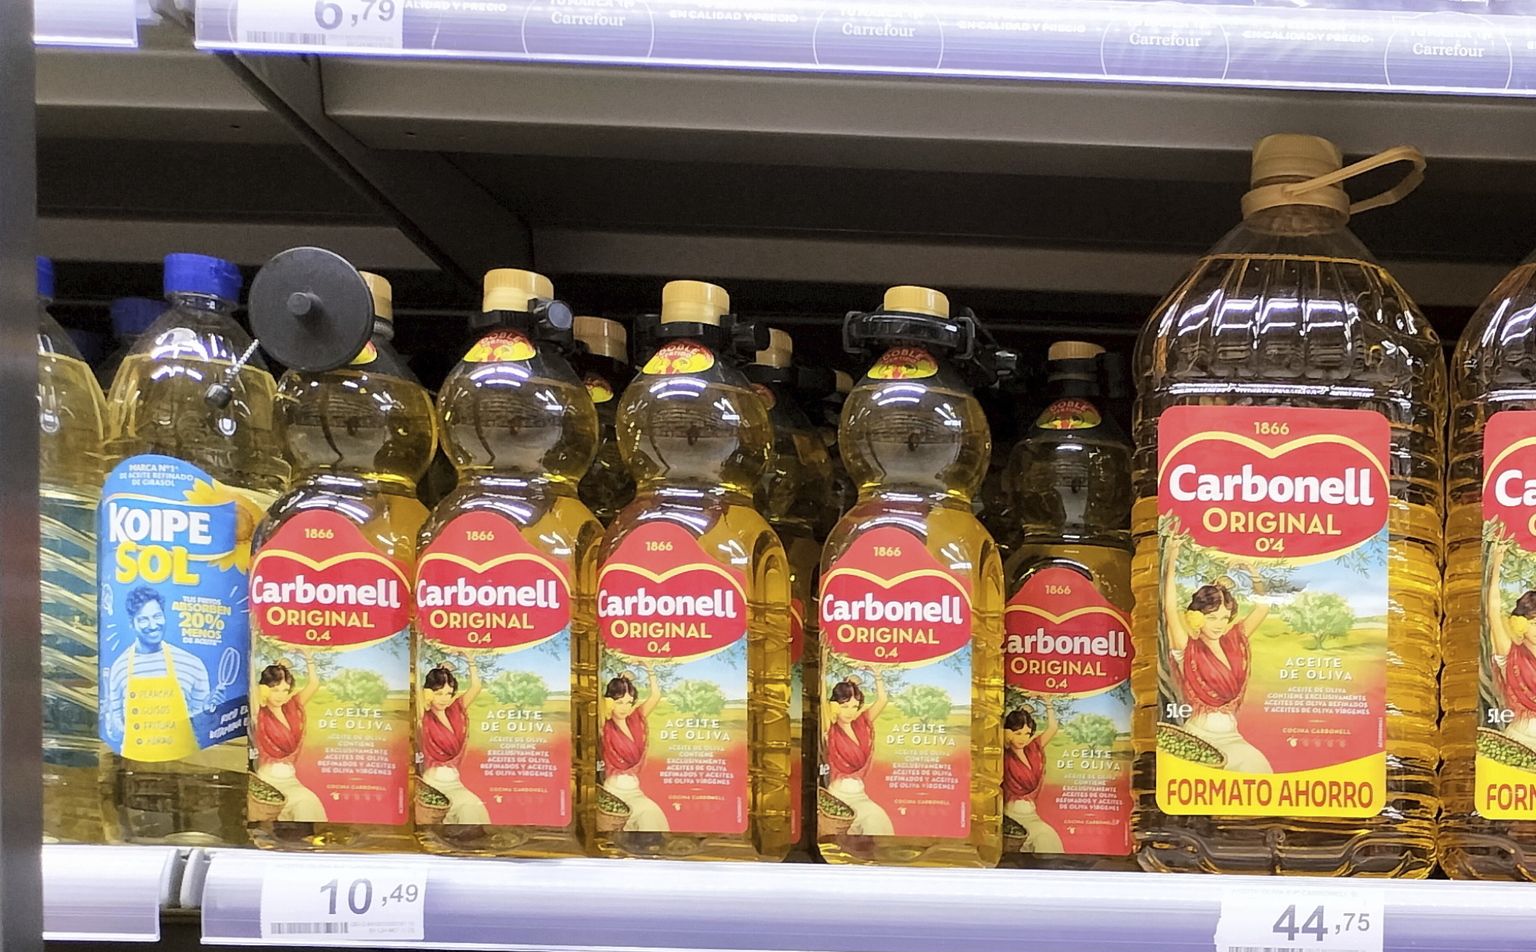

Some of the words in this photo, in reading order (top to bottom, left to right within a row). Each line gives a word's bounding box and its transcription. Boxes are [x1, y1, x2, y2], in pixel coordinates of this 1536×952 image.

[551, 11, 626, 27] Carrefour
[842, 22, 916, 38] Carrefour
[1253, 422, 1290, 435] 1866
[1169, 463, 1375, 507] Carbonell
[109, 501, 212, 545] KOIPE
[1203, 507, 1342, 535] ORIGINAL
[304, 527, 334, 539] 1866
[466, 530, 495, 541] 1866
[645, 540, 674, 552] 1866
[873, 546, 902, 557] 1866
[115, 541, 200, 585] SOL
[252, 574, 402, 608] Carbonell
[416, 577, 560, 609] Carbonell
[1044, 584, 1072, 595] 1866
[598, 588, 738, 619] Carbonell
[823, 593, 962, 625] Carbonell
[179, 611, 225, 631] 20%
[266, 606, 375, 627] ORIGINAL
[430, 609, 535, 629] ORIGINAL
[610, 619, 713, 640] ORIGINAL
[837, 625, 940, 646] ORIGINAL
[1004, 628, 1127, 658] arbonell
[1010, 657, 1107, 677] ORIGINAL
[1285, 657, 1342, 669] ACEITE
[1279, 669, 1299, 680] DE
[1306, 670, 1353, 682] OLIVA
[325, 707, 382, 719] ACEITE
[319, 718, 340, 729] DE
[345, 719, 394, 732] OLIVA
[1167, 779, 1271, 807] FORMATO
[1277, 780, 1373, 809] AHORRO
